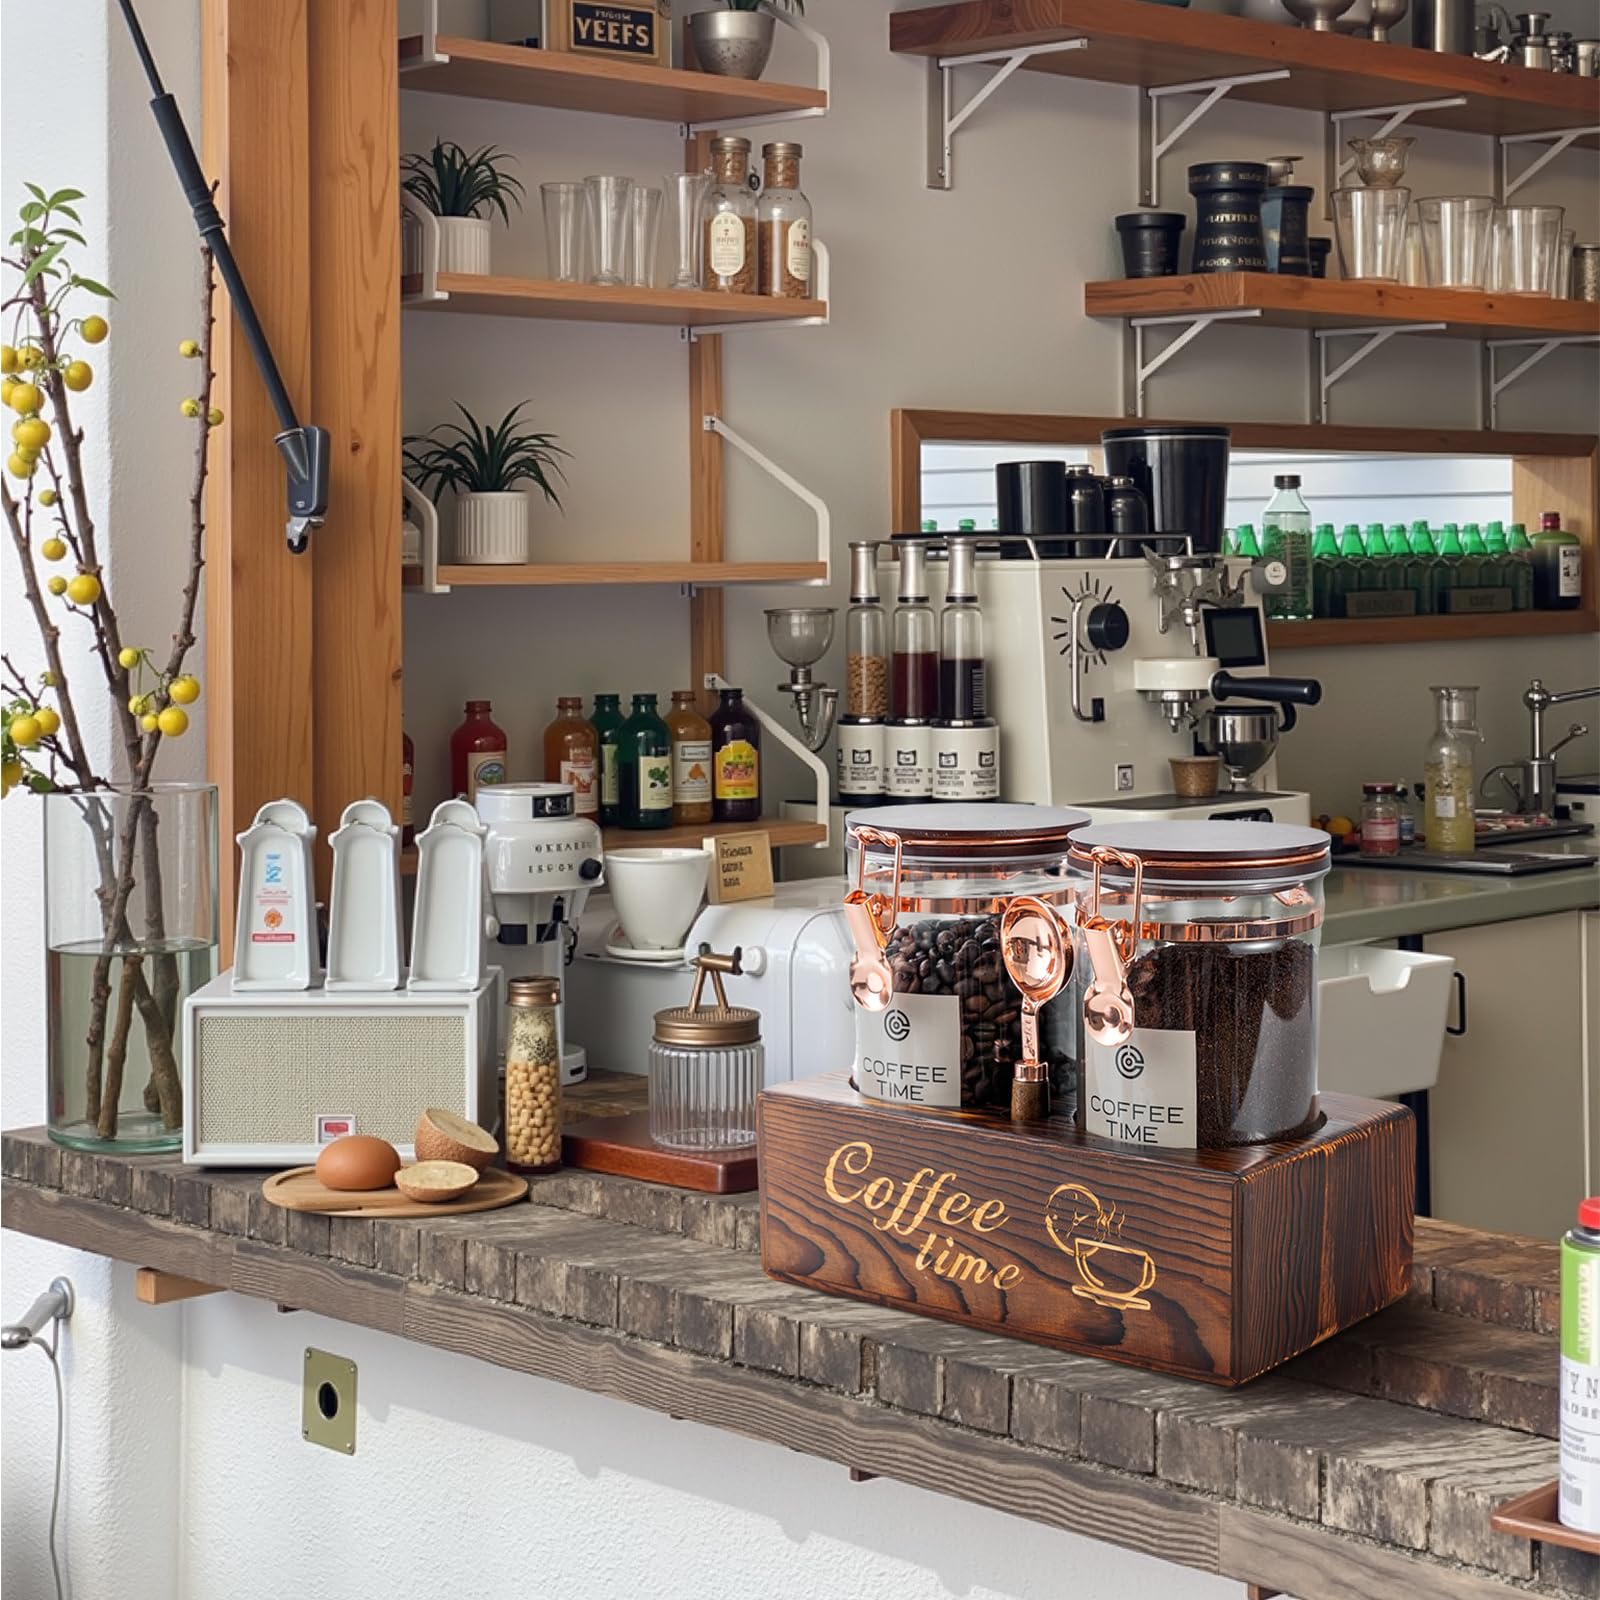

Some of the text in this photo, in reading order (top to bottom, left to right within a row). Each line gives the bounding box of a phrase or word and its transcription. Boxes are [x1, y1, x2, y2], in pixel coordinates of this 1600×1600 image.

[575, 16, 649, 47] YEEFS
[862, 1056, 948, 1084] COFFEE
[876, 1079, 925, 1102] TIME
[1090, 1094, 1184, 1124] COFFEE
[1105, 1119, 1159, 1144] TIME
[824, 1141, 1010, 1236] Coffee
[915, 1232, 1024, 1290] time
